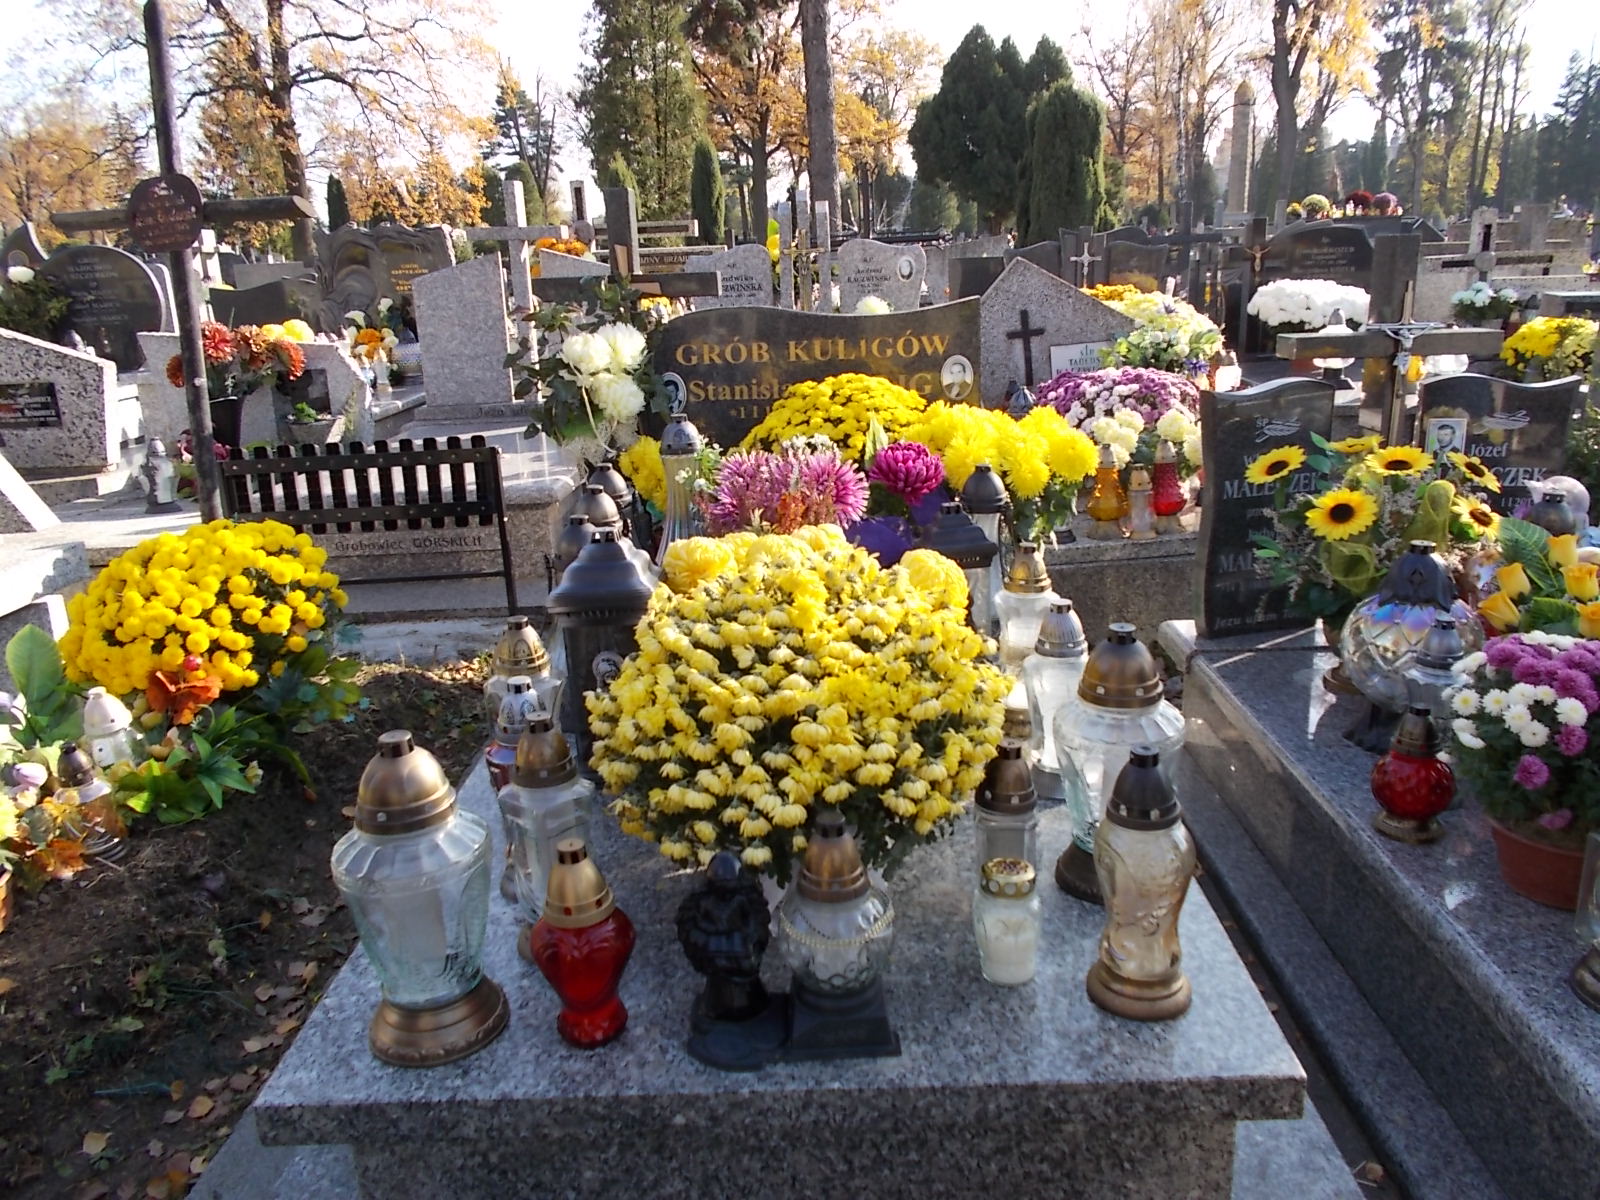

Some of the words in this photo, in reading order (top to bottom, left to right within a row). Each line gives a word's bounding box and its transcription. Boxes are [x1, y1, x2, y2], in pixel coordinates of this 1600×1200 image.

[676, 337, 769, 366] GRÓB
[788, 329, 949, 362] KULIGÓW
[1469, 442, 1508, 458] Józef
